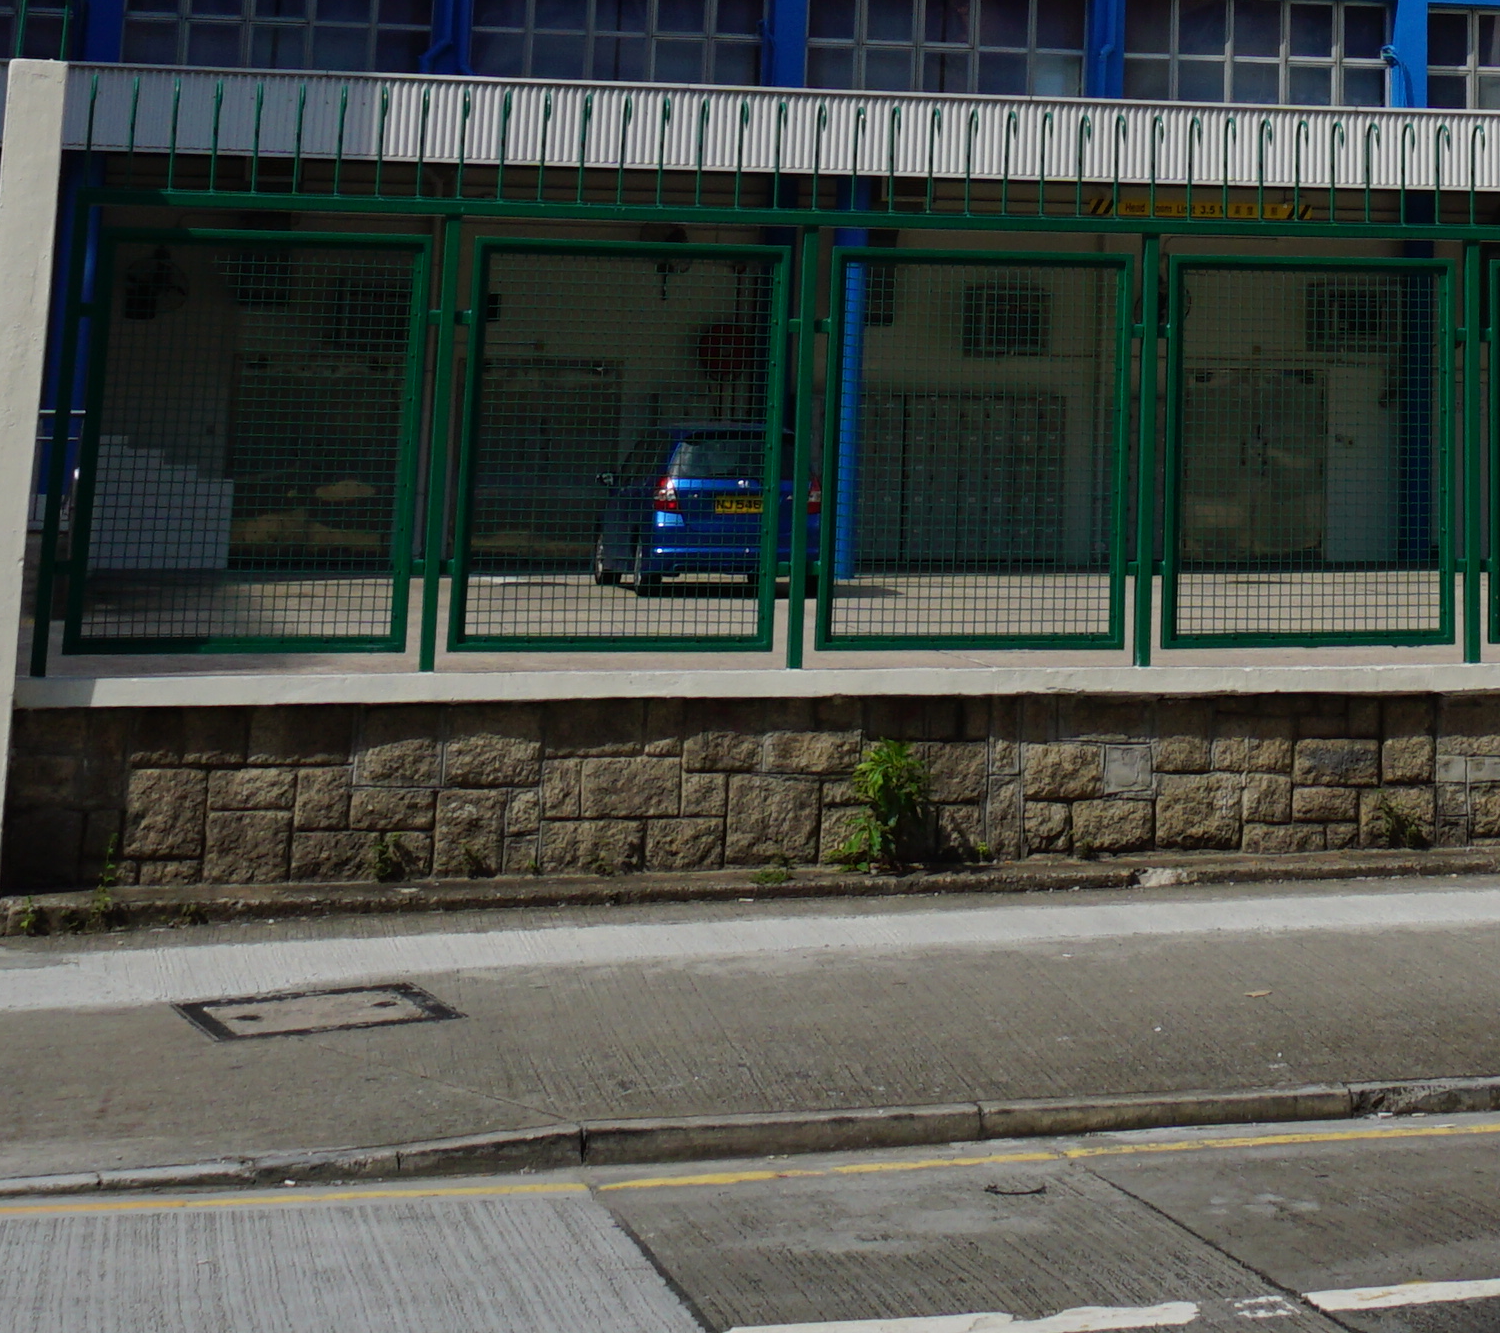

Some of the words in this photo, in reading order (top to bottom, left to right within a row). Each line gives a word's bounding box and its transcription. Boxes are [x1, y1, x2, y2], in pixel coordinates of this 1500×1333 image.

[1125, 203, 1146, 213] Head
[1200, 205, 1216, 215] 3.5
[736, 499, 762, 510] 546
